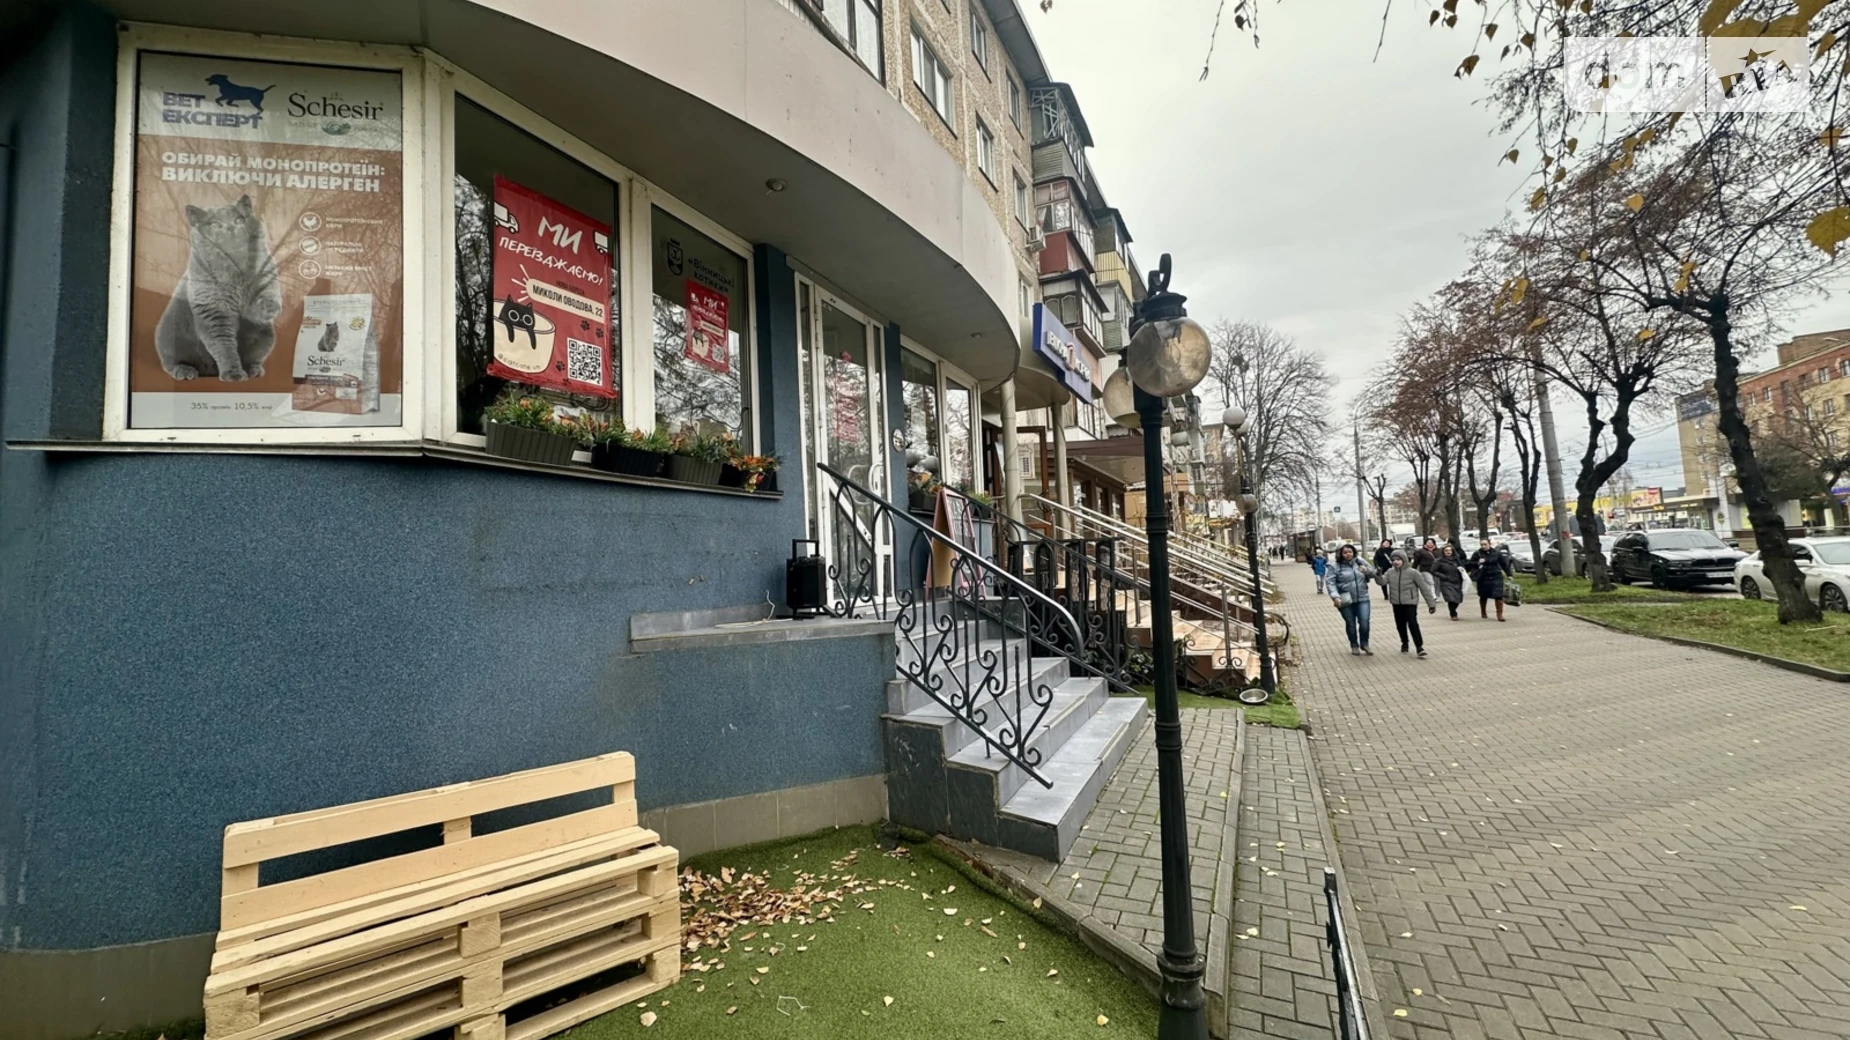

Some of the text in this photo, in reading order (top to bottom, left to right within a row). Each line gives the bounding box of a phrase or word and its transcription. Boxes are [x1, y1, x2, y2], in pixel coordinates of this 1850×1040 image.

[163, 92, 206, 108] ВЕТ
[288, 92, 384, 120] Schesir
[163, 109, 263, 129] ЕКСПЕРТ
[162, 151, 385, 176] ОБИРАЙ МОНОПРОТЕЇН:
[162, 167, 380, 193] ВИКЛЮЧИ АЛЕРГЕН
[538, 216, 583, 255] МИ
[532, 285, 563, 303] МИКОЛИ
[595, 307, 604, 318] 22
[307, 355, 345, 367] Schesir
[191, 402, 209, 410] 35%
